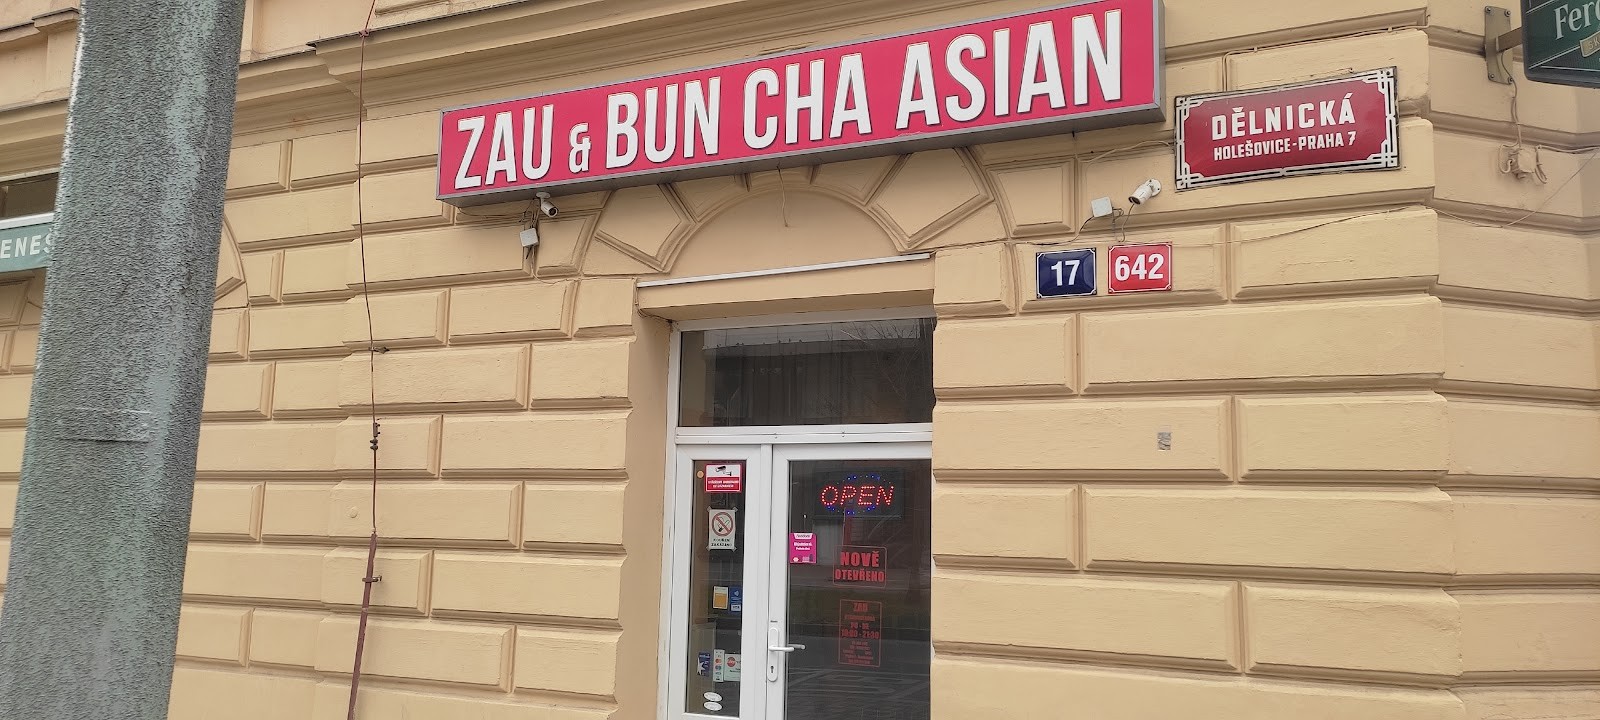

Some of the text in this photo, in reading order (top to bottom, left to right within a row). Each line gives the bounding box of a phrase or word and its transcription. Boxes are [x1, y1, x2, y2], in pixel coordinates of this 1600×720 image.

[454, 9, 1122, 189] ZAU & BUN CHA ASIAN
[1211, 93, 1356, 140] DĚLNICKÁ
[1348, 131, 1357, 146] 7
[1050, 260, 1081, 287] 17
[1114, 253, 1165, 282] 642
[820, 485, 895, 507] OPEN
[840, 551, 880, 568] NOVĚ
[834, 568, 885, 583] OTEVŘENO
